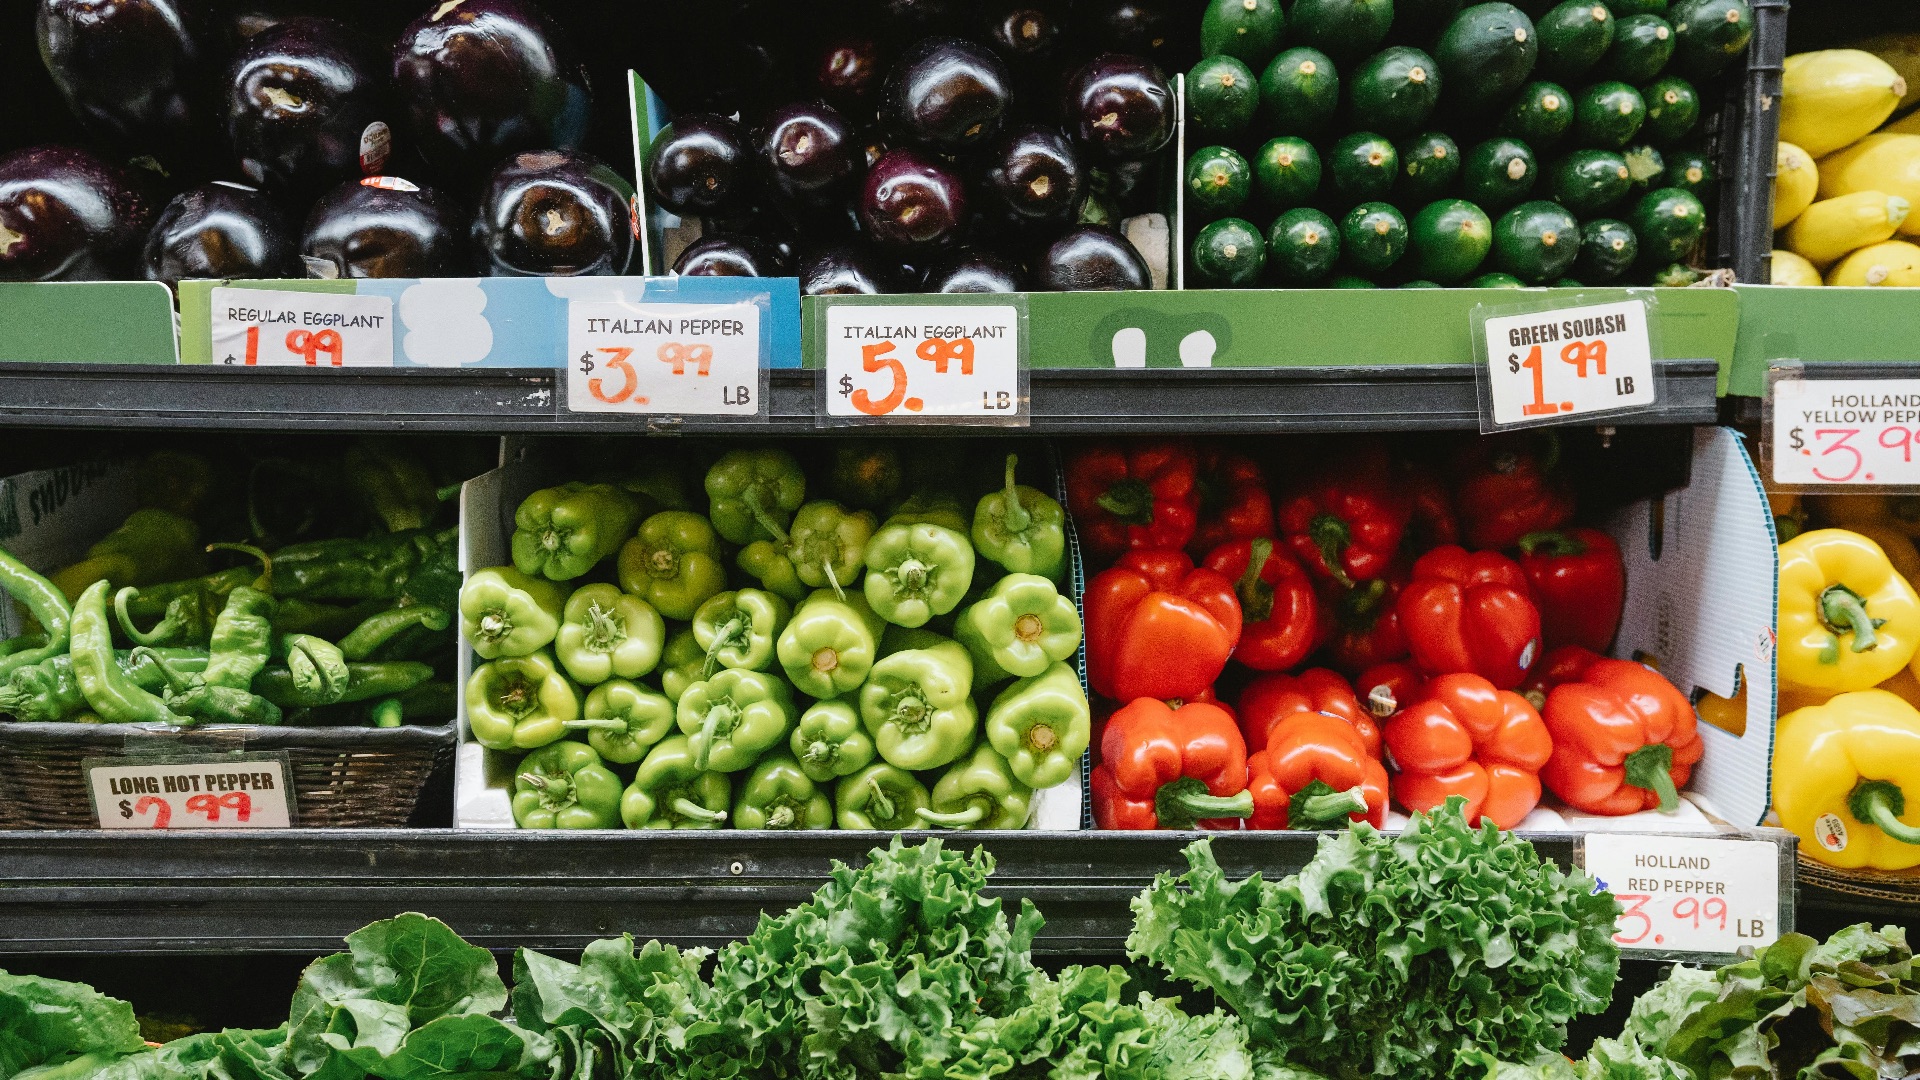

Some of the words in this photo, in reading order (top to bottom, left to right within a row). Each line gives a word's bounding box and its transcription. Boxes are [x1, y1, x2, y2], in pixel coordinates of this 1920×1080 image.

[228, 308, 296, 324] REGULAR
[303, 312, 384, 328] EGGPLANT
[587, 318, 672, 335] ITALIAN
[680, 319, 744, 336] PEPPER
[843, 326, 917, 339] ITALIAN
[923, 326, 1007, 339] EGGPLANT
[1509, 323, 1560, 347] GREEN
[723, 385, 751, 405] LB
[1615, 376, 1635, 395] LB
[983, 391, 1011, 410] LB
[1832, 395, 1920, 407] HOLLAND
[1803, 411, 1877, 423] YELLOW
[1884, 411, 1920, 423] PEP
[109, 777, 160, 796] LONG
[162, 774, 200, 794] HOT
[205, 772, 275, 792] PEPPER
[1635, 854, 1710, 870] HOLLAND
[1628, 878, 1659, 892] RED
[1664, 879, 1725, 894] PEPPER
[1736, 919, 1764, 938] LB
